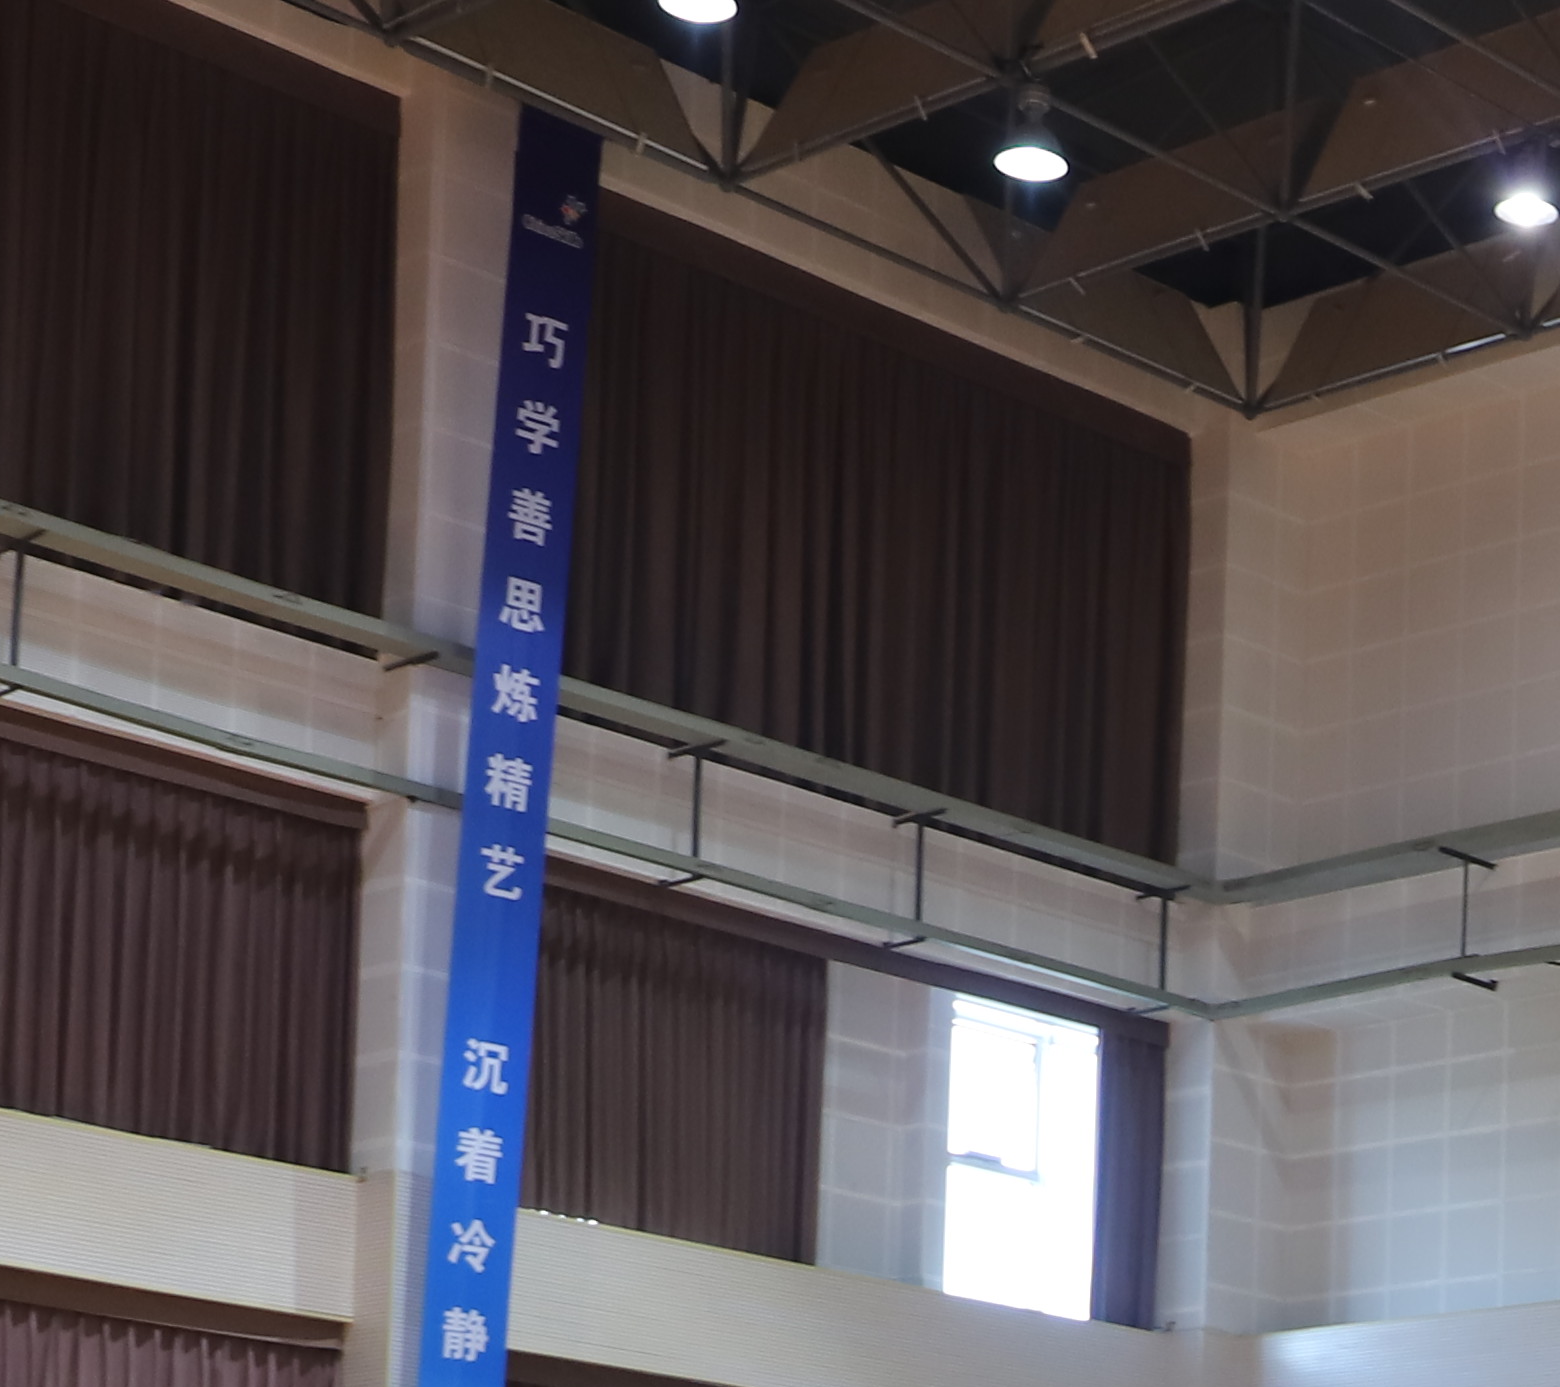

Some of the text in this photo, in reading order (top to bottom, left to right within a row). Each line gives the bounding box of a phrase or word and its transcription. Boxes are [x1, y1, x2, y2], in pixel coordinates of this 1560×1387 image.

[478, 310, 571, 904] 巧学善思炼精艺
